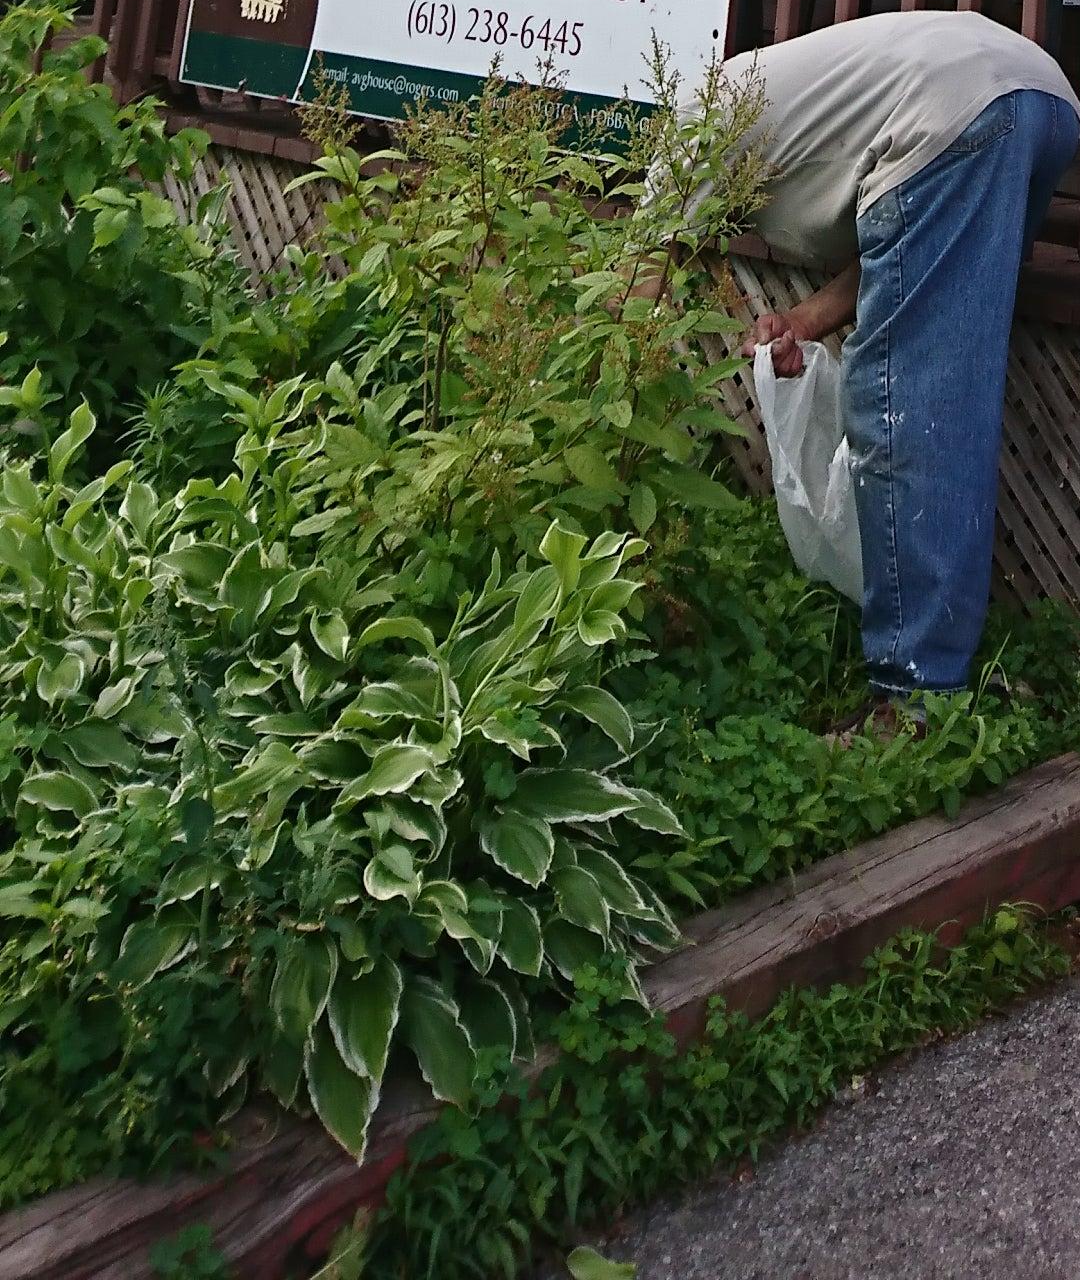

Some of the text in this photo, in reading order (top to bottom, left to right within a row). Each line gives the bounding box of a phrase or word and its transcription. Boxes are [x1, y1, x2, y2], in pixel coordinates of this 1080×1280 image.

[407, 0, 584, 57] (613) 238-6445
[324, 67, 349, 83] email:
[351, 71, 459, 101] avghouse@rogers.com
